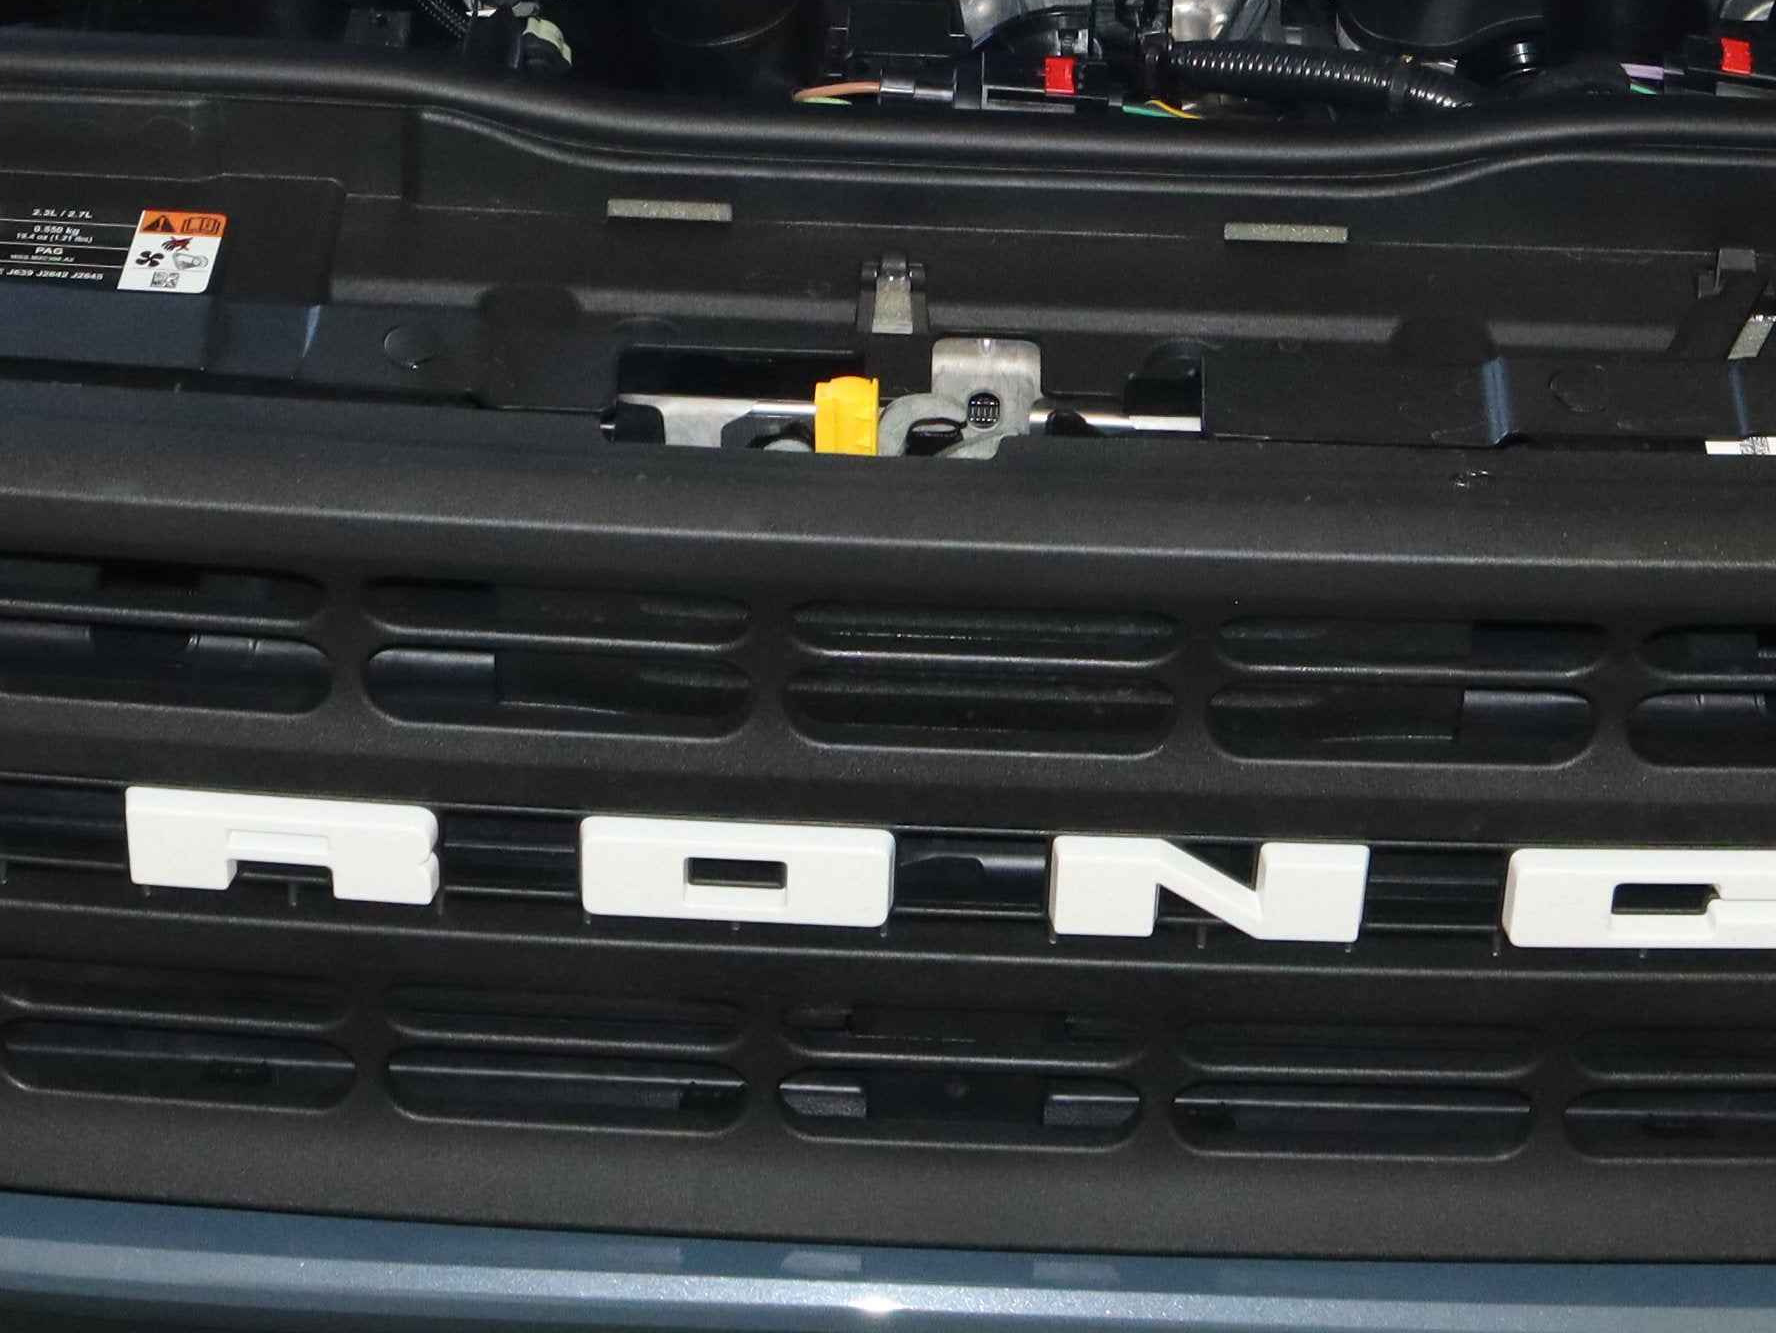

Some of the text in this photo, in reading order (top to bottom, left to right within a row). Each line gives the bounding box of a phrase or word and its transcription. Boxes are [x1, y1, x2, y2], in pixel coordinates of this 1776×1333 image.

[32, 208, 57, 218] 2.3L
[67, 210, 93, 219] 2.7L
[65, 226, 81, 236] kg
[34, 246, 64, 255] PAG
[6, 268, 34, 276] J639
[35, 269, 70, 278] J2842
